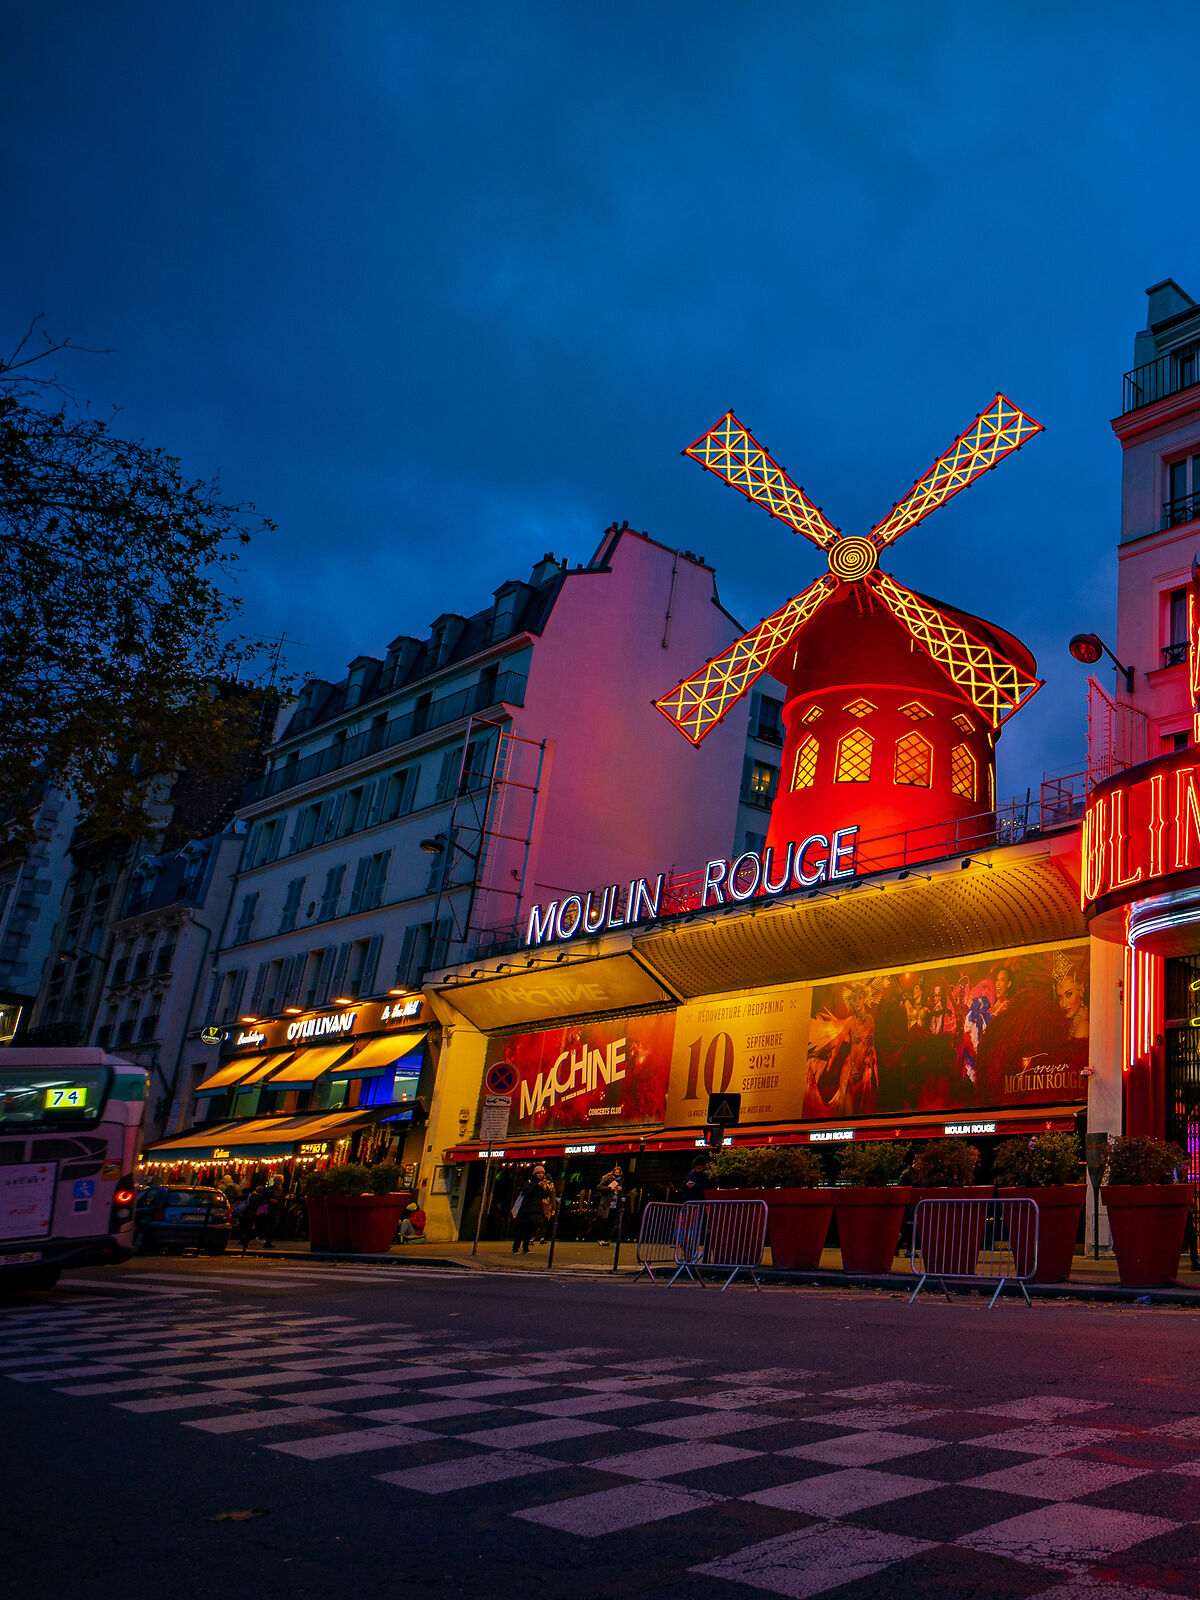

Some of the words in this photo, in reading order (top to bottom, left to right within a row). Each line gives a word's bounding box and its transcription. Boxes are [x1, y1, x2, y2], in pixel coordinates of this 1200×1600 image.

[526, 873, 666, 947] MOULIN
[702, 825, 860, 906] ROUGE
[747, 1000, 785, 1017] REOPENING
[286, 1011, 356, 1040] O'SULLIVANS
[746, 1033, 784, 1049] SEPTEMBRE
[680, 1032, 735, 1100] 10
[748, 1054, 776, 1070] 2021
[1016, 1053, 1070, 1081] Forever
[519, 1037, 626, 1120] MACHINE
[742, 1075, 779, 1090] SEPTEMBER
[1004, 1074, 1044, 1094] MOULIN
[1046, 1070, 1084, 1089] ROUGE
[52, 1090, 81, 1107] 74
[588, 1107, 610, 1116] CONCERTS
[610, 1106, 622, 1114] CLUB
[810, 1132, 832, 1141] MOULIN
[833, 1131, 854, 1140] ROUGE
[944, 1125, 973, 1136] MOULIN
[974, 1123, 996, 1134] ROUGE
